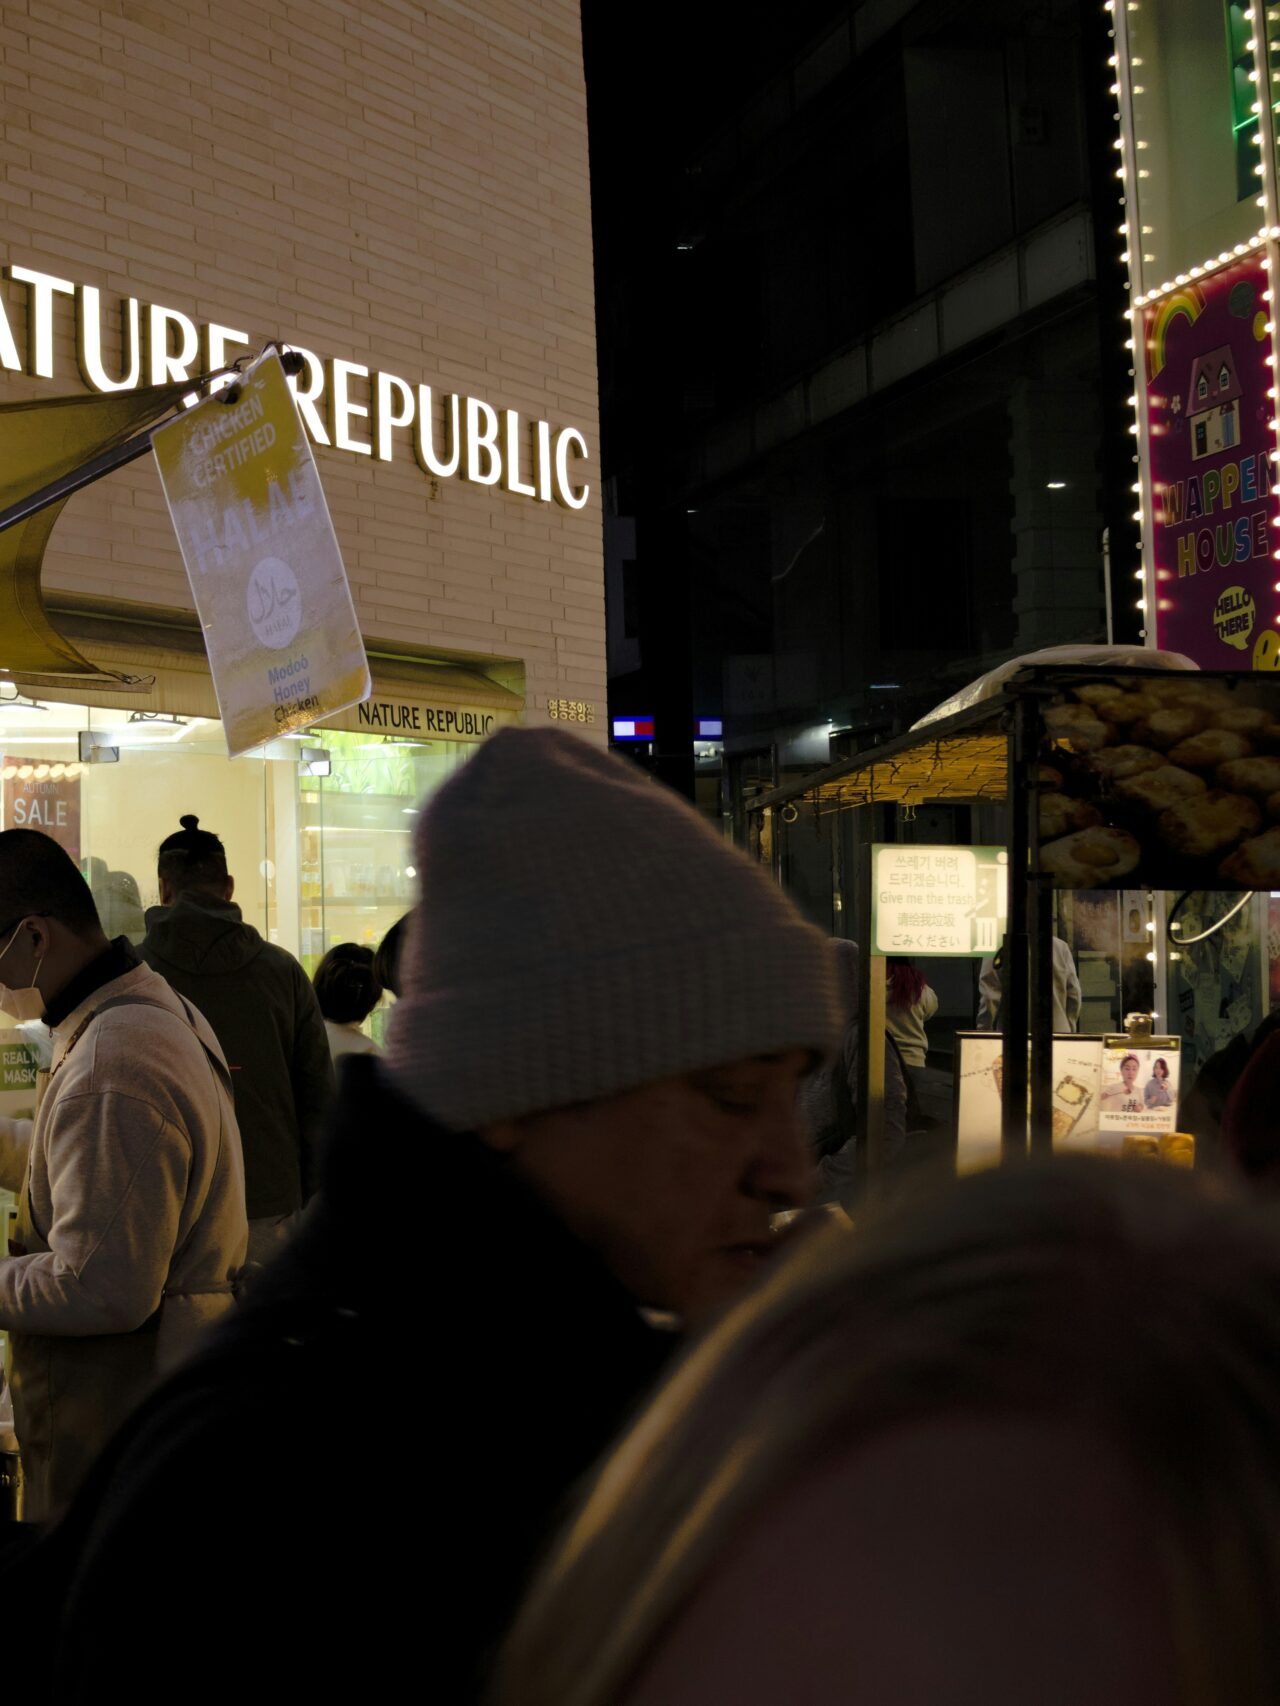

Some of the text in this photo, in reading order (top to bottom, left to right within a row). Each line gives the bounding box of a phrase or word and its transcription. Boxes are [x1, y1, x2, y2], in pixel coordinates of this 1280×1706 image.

[190, 394, 265, 457] CHICKEN
[280, 346, 589, 510] REPUBLIC
[192, 422, 277, 489] CERTIFIED
[1162, 447, 1277, 528] WAPPEN
[190, 469, 317, 574] HALAL
[1177, 510, 1269, 579] HOUSE
[1215, 590, 1251, 618] HELLO
[267, 657, 309, 686] Modoo
[272, 676, 310, 704] Honey
[273, 694, 320, 723] Chicken
[357, 702, 494, 737] NATURE REPUBLIC
[13, 797, 68, 827] SALE
[895, 855, 959, 871] 쓰레기 버려
[879, 891, 904, 905] Give
[906, 894, 923, 904] me
[926, 892, 946, 905] the
[890, 934, 961, 947] ごみください
[2, 1051, 31, 1065] REAL
[4, 1068, 37, 1085] MASK
